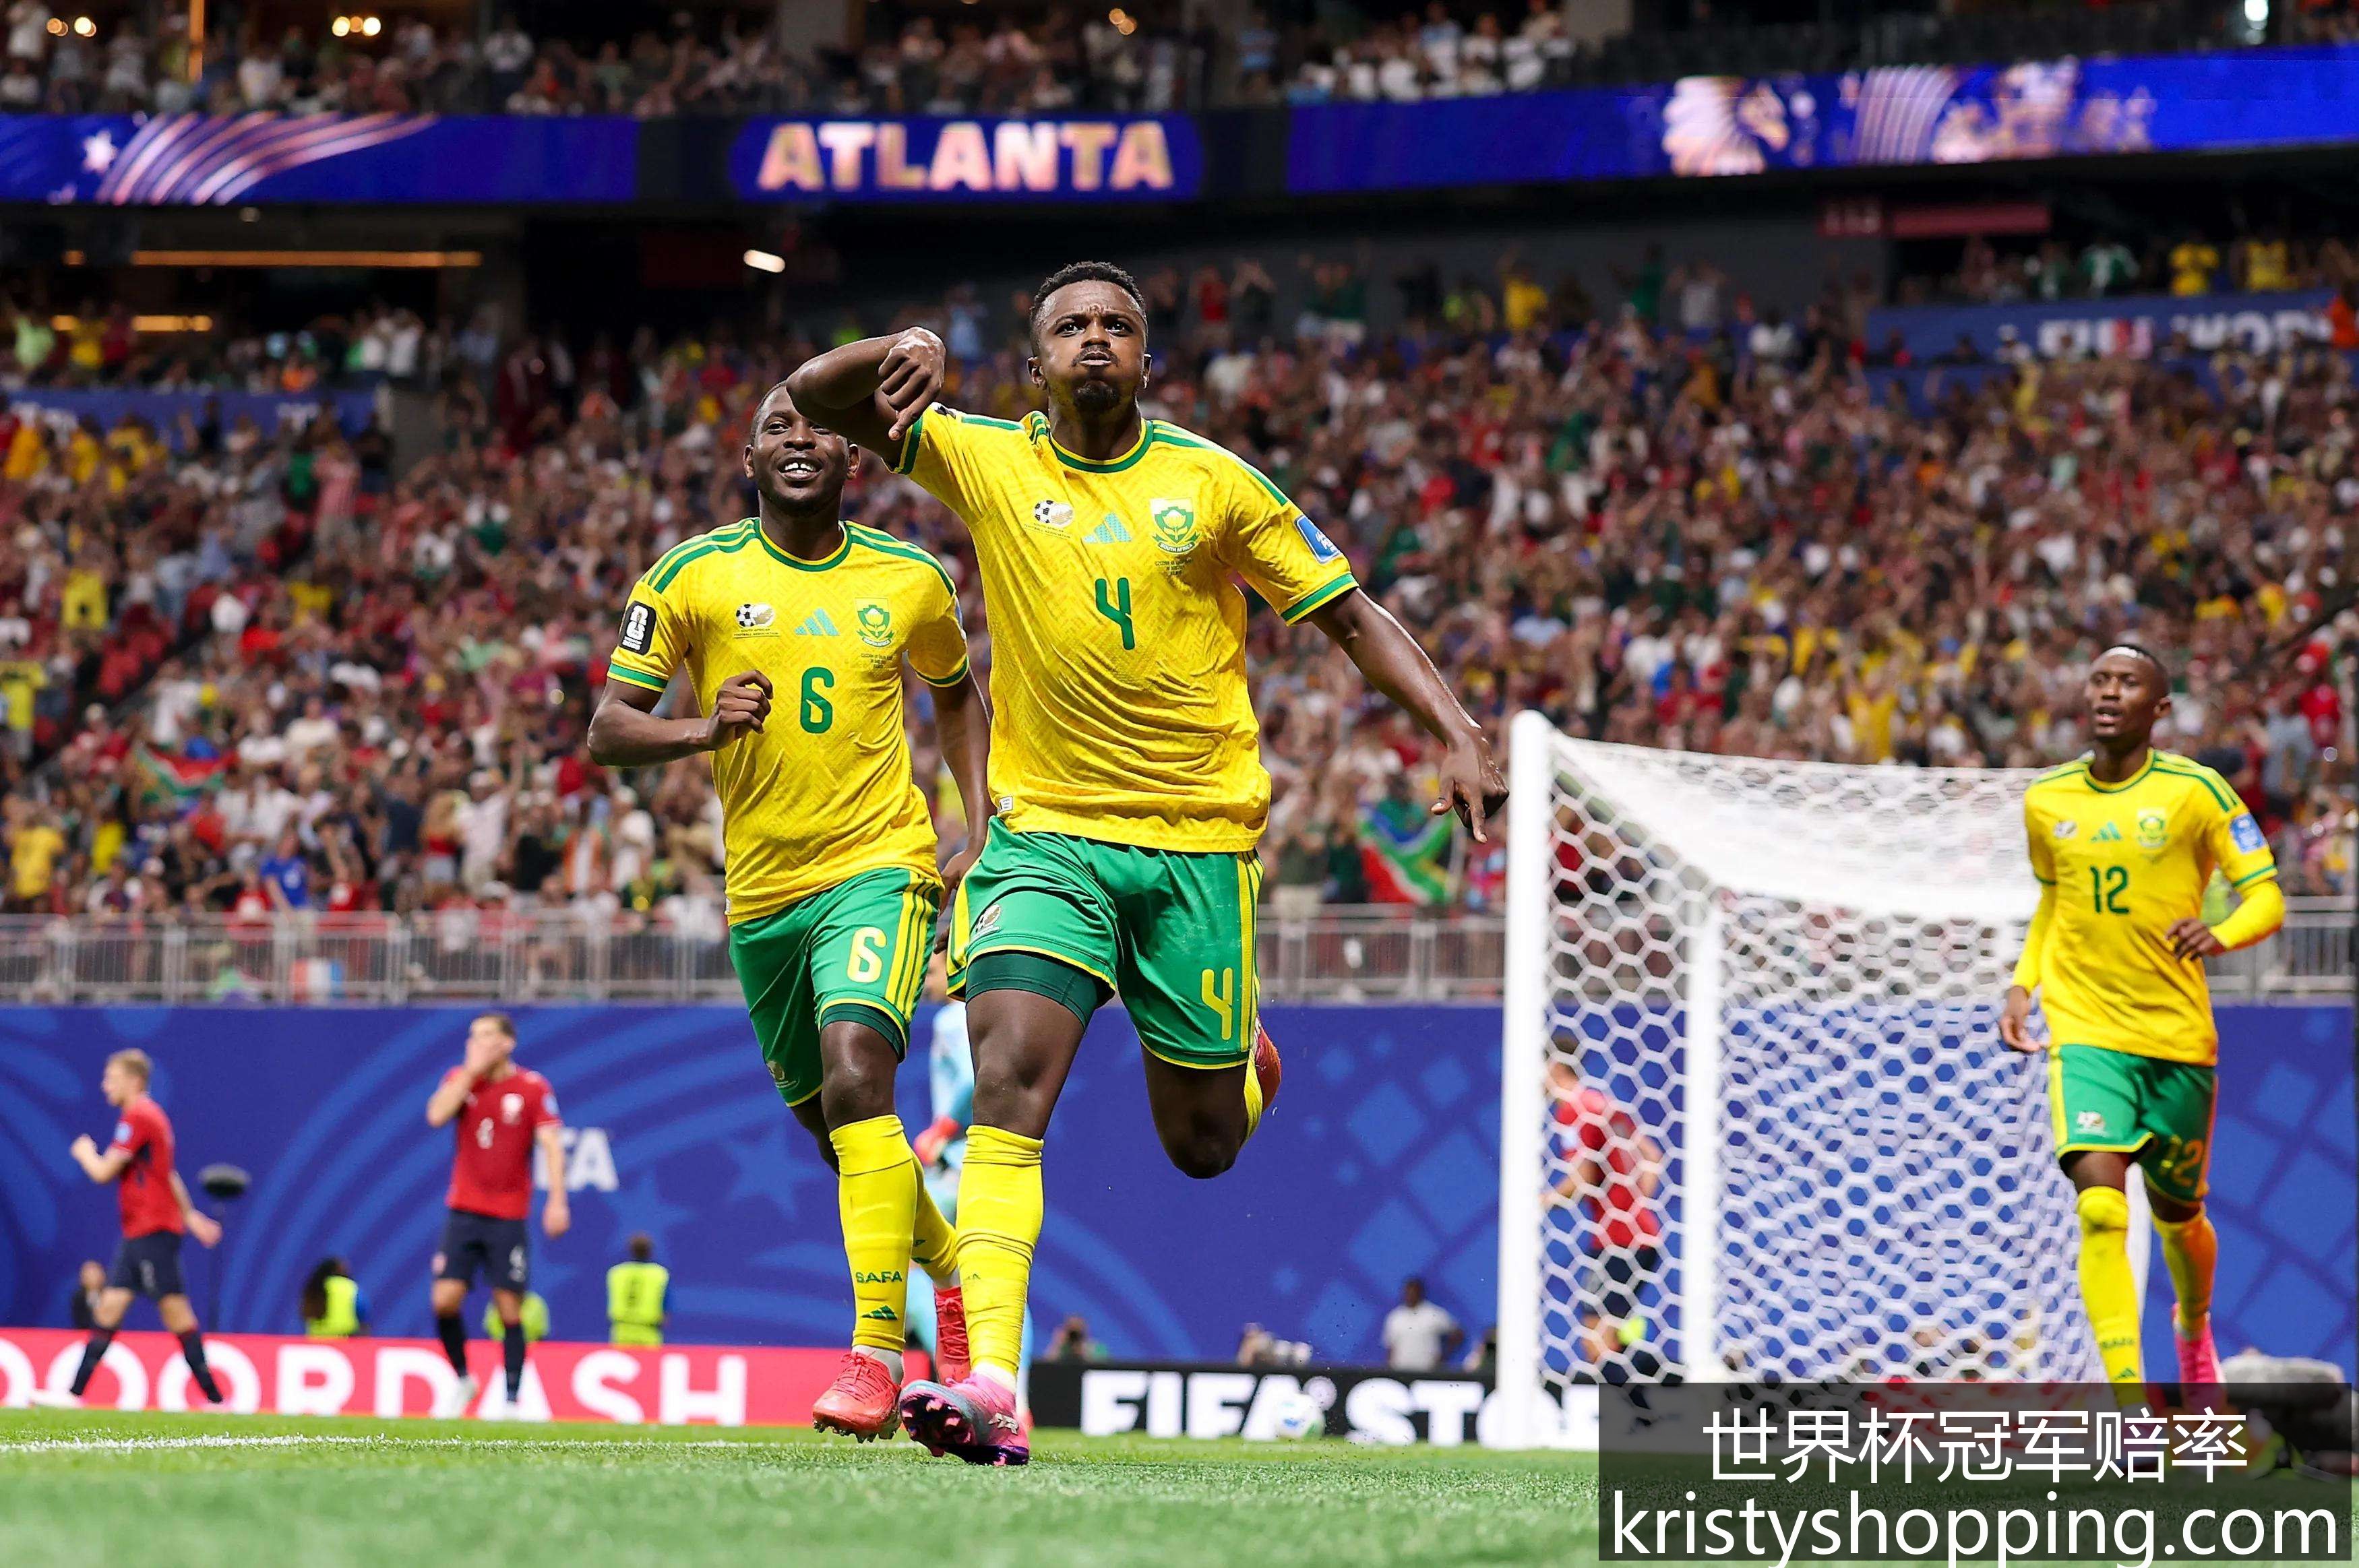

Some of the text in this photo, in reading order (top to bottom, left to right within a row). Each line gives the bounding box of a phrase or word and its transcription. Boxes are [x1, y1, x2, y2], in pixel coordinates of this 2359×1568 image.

[757, 121, 1173, 191] ATLANTA
[1095, 577, 1135, 650] 4
[799, 666, 834, 734] 6
[2089, 865, 2130, 914] 12
[847, 926, 887, 983] 6
[1201, 967, 1233, 1041] 4
[855, 1270, 902, 1284] SAFA
